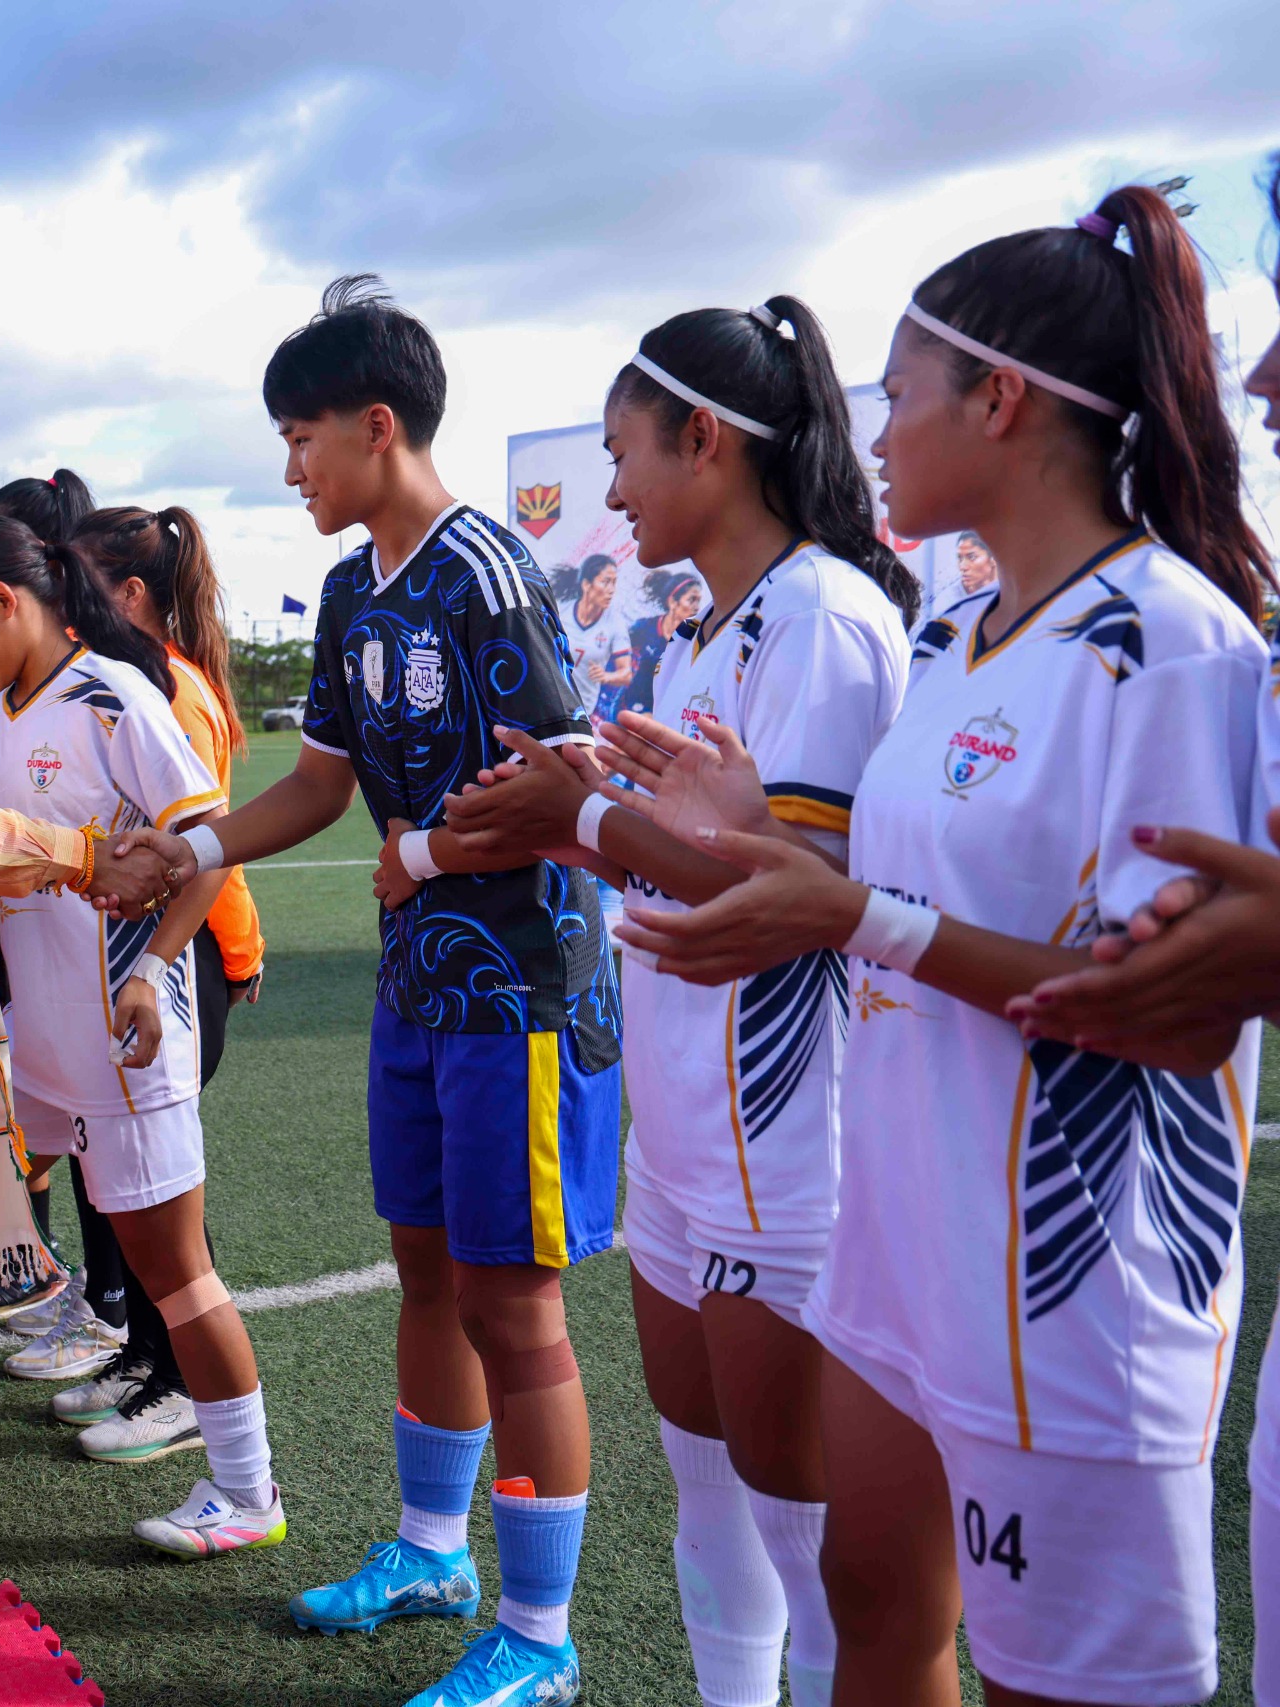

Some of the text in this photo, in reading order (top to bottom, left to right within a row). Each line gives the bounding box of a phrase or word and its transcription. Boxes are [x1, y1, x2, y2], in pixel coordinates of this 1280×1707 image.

[412, 666, 434, 693] AFA
[681, 708, 719, 724] DURD
[949, 732, 1017, 762] DURAND
[963, 751, 981, 761] CUP
[27, 760, 62, 769] DURAND
[964, 1497, 1028, 1582] 04
